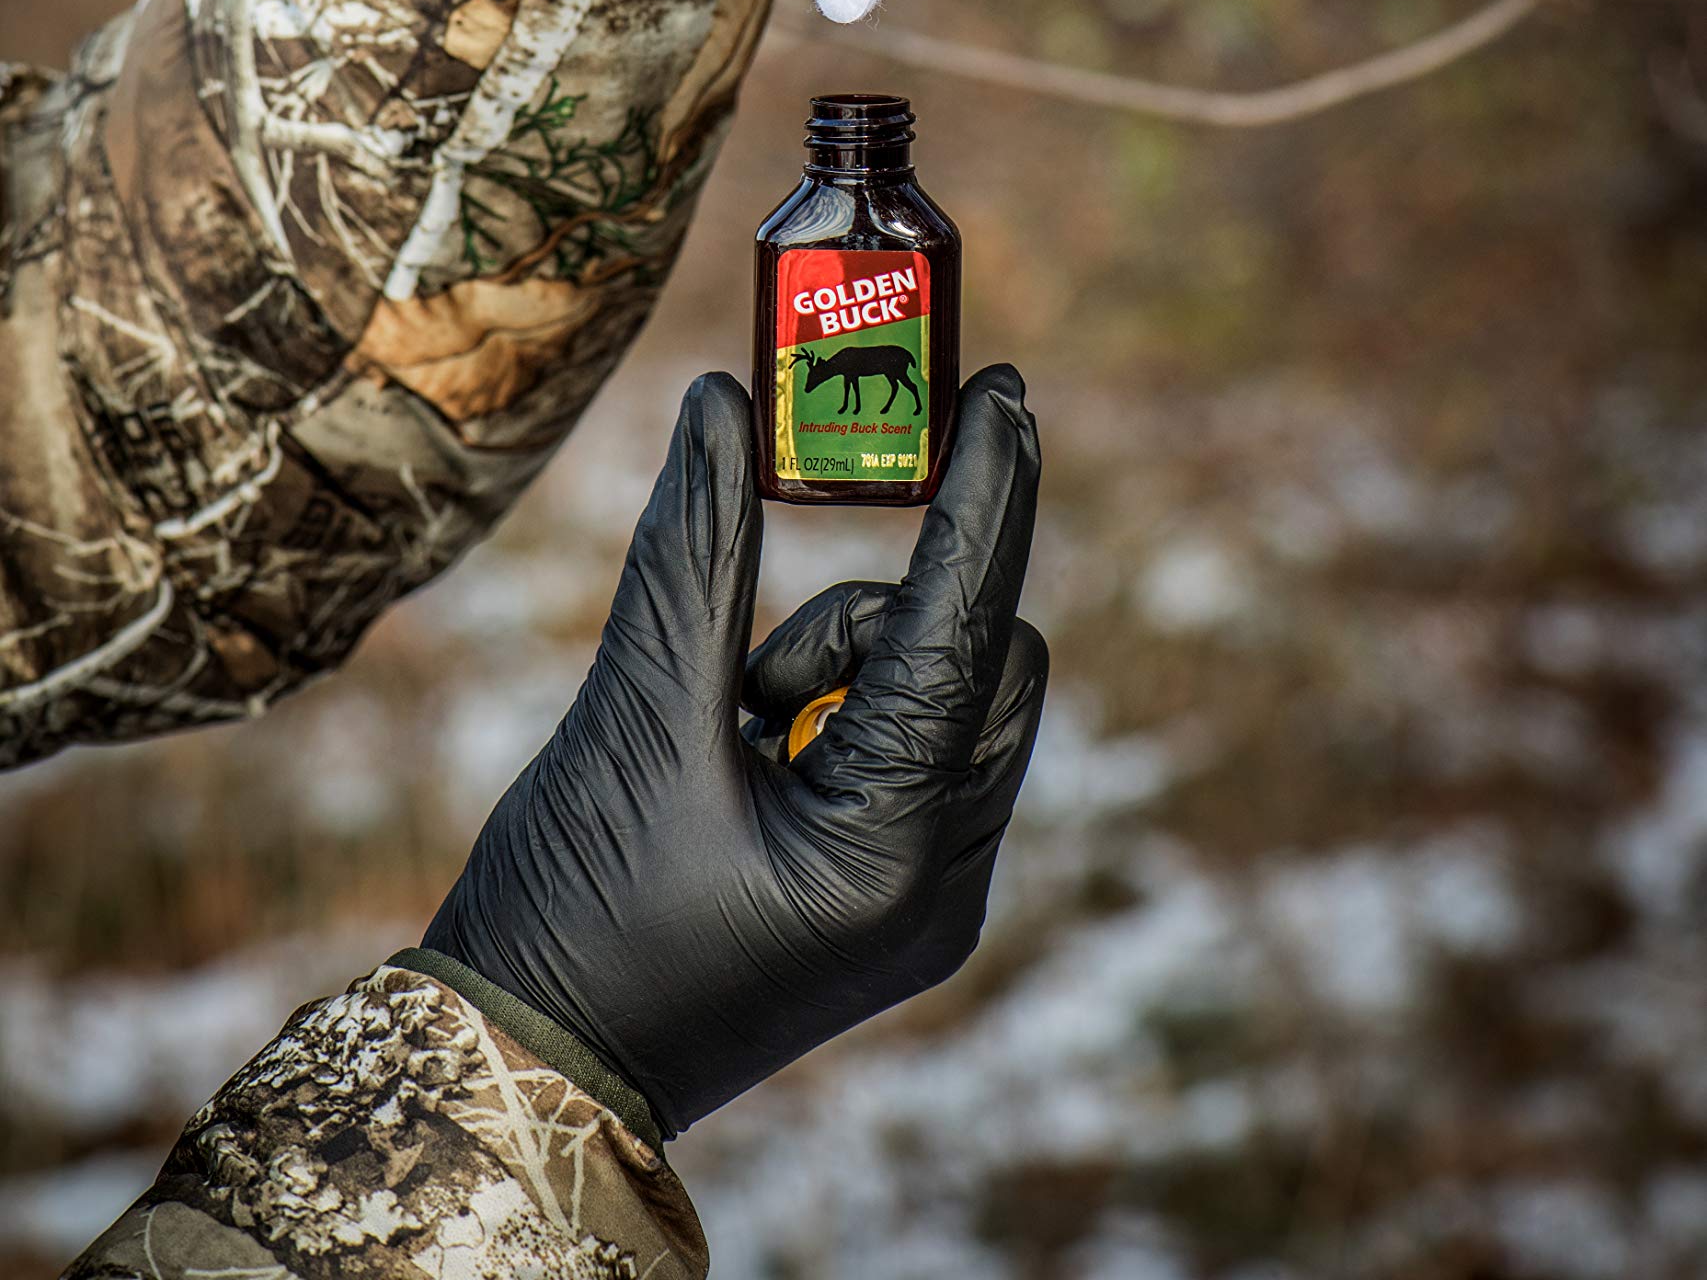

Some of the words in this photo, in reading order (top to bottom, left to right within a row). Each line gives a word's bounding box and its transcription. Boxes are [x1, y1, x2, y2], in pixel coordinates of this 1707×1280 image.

[793, 267, 917, 314] GOLDEN
[798, 422, 848, 435] Intruding
[850, 422, 878, 434] Buck
[880, 423, 912, 435] Scent
[782, 457, 786, 470] 1
[790, 458, 800, 471] FL
[881, 453, 896, 468] EXP
